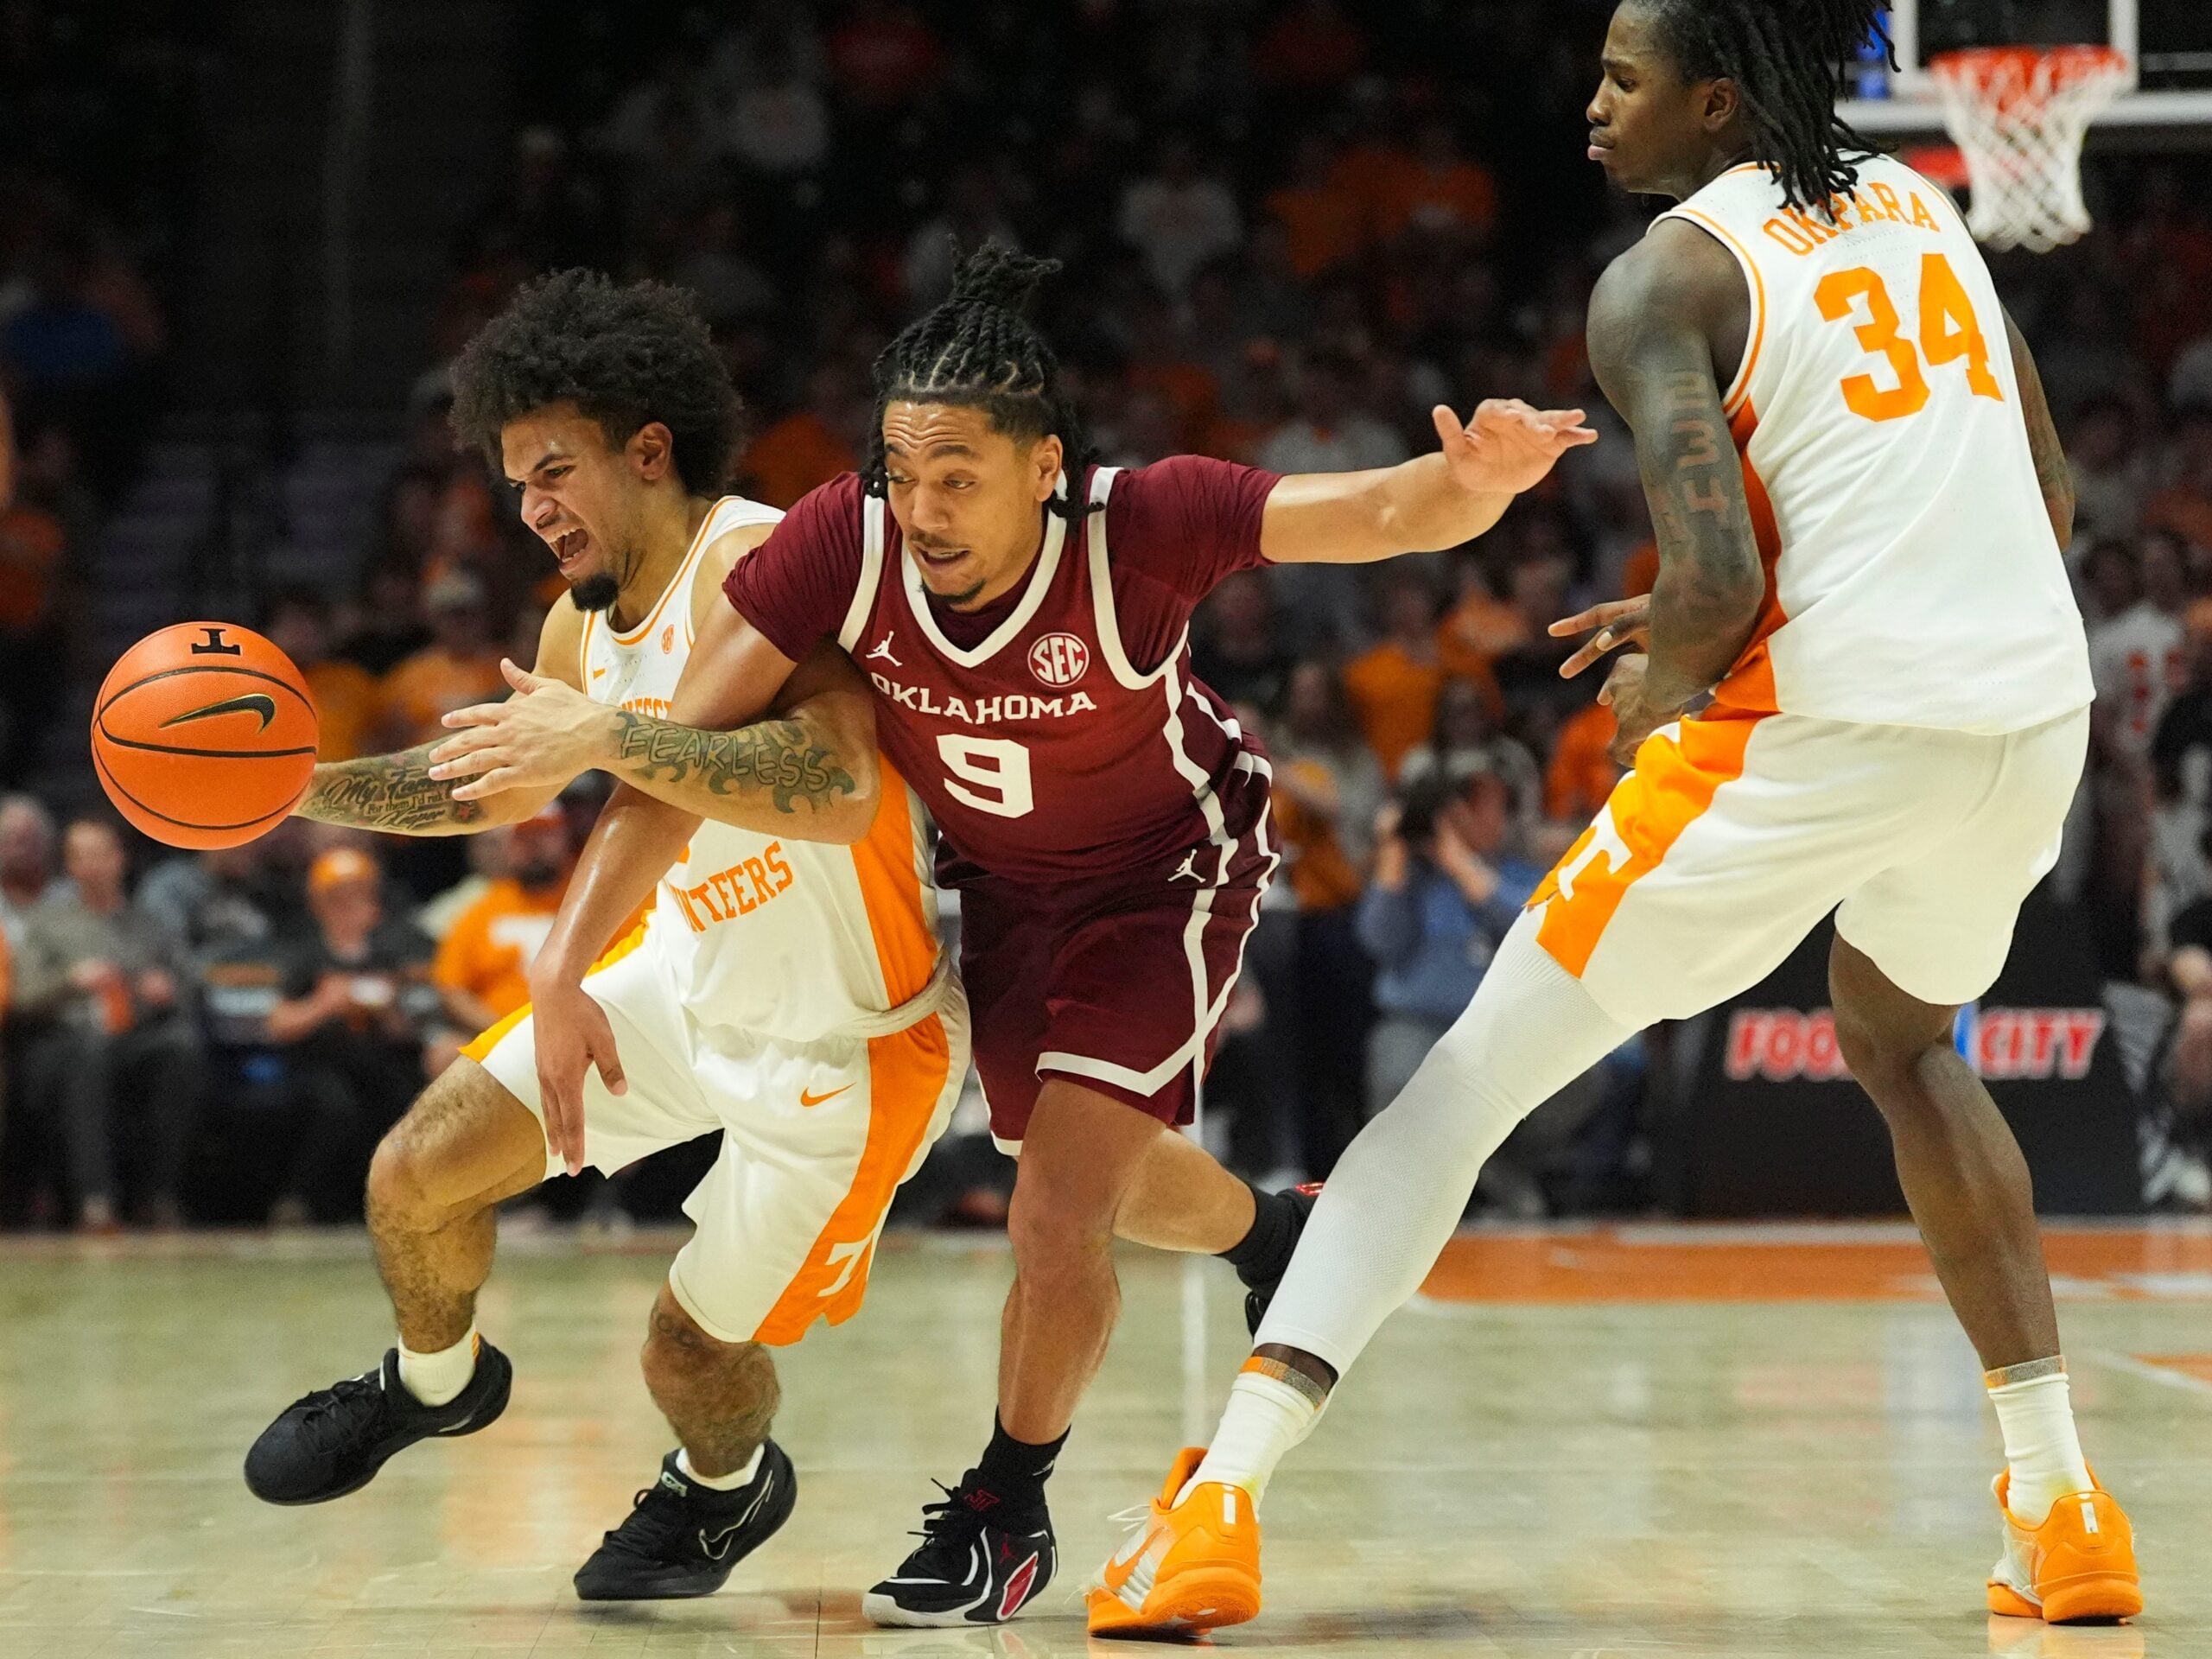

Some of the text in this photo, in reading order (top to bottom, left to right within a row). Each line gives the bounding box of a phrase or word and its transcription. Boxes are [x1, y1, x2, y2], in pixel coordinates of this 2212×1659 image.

[1763, 182, 1941, 257] OKPARA
[1813, 253, 2005, 423] 34
[1032, 636, 1084, 684] SEC
[870, 671, 1097, 725] OKLAHOMA
[620, 721, 830, 792] FEARLESS
[936, 733, 1034, 819] 9
[1725, 1007, 2104, 1080] FOO CITY
